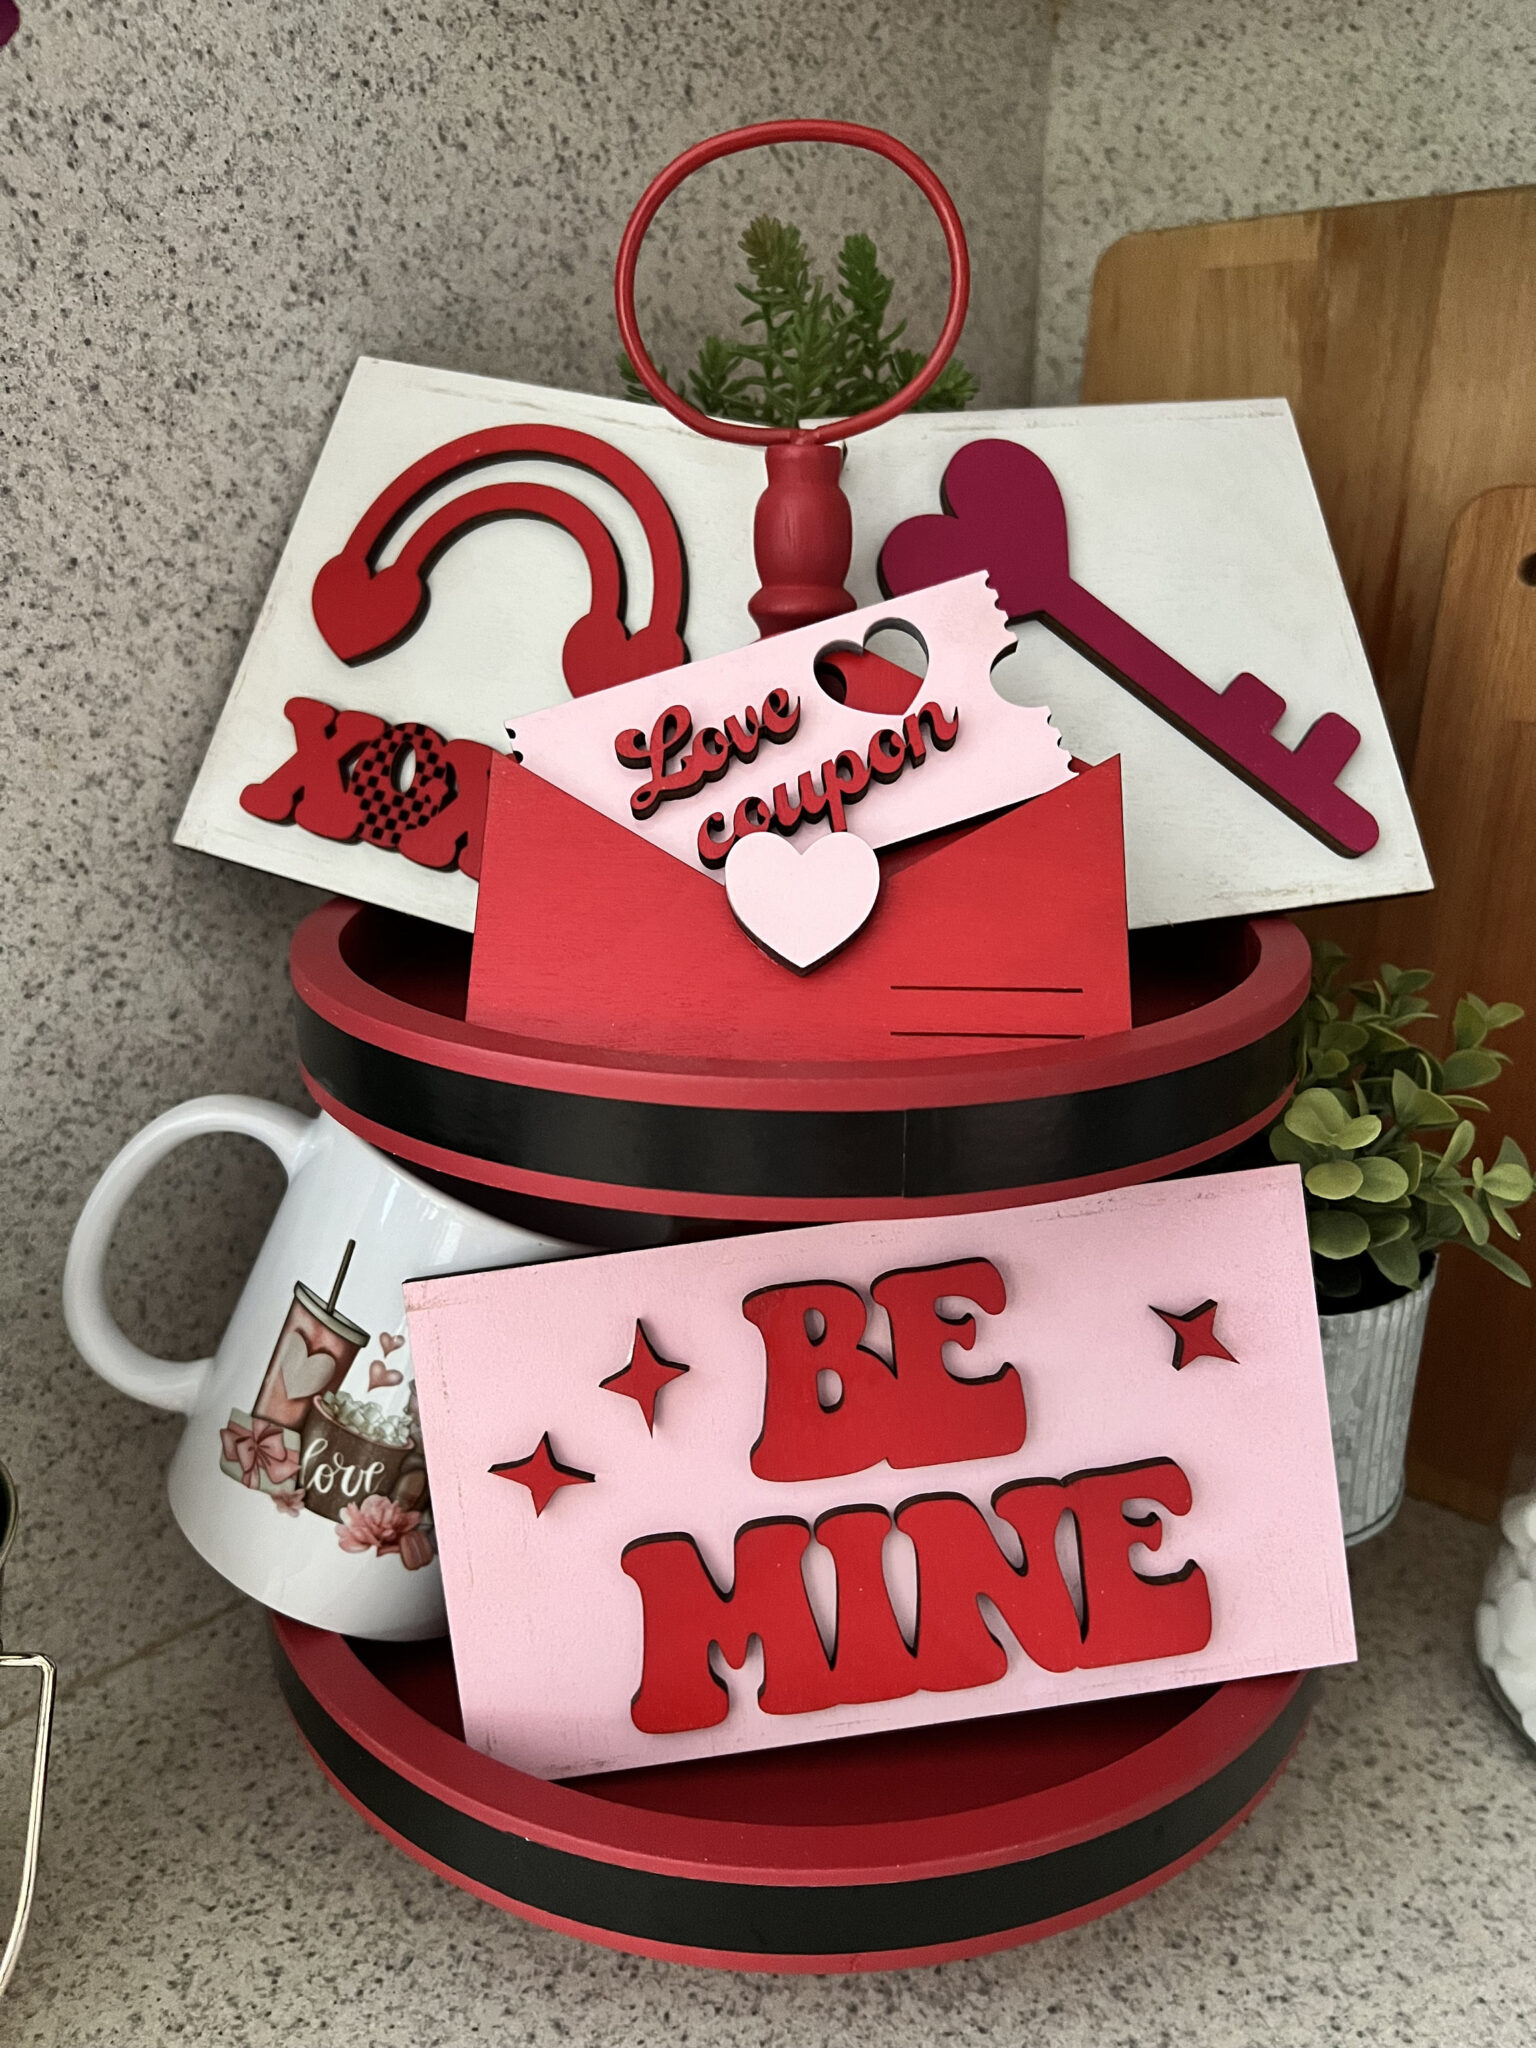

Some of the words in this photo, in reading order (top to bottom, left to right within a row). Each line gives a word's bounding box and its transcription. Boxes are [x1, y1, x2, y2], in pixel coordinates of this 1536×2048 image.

[614, 687, 801, 820] Love
[697, 701, 960, 870] coupon
[742, 1257, 1028, 1483] BE
[303, 1437, 386, 1497] love
[621, 1456, 1213, 1735] MINE
